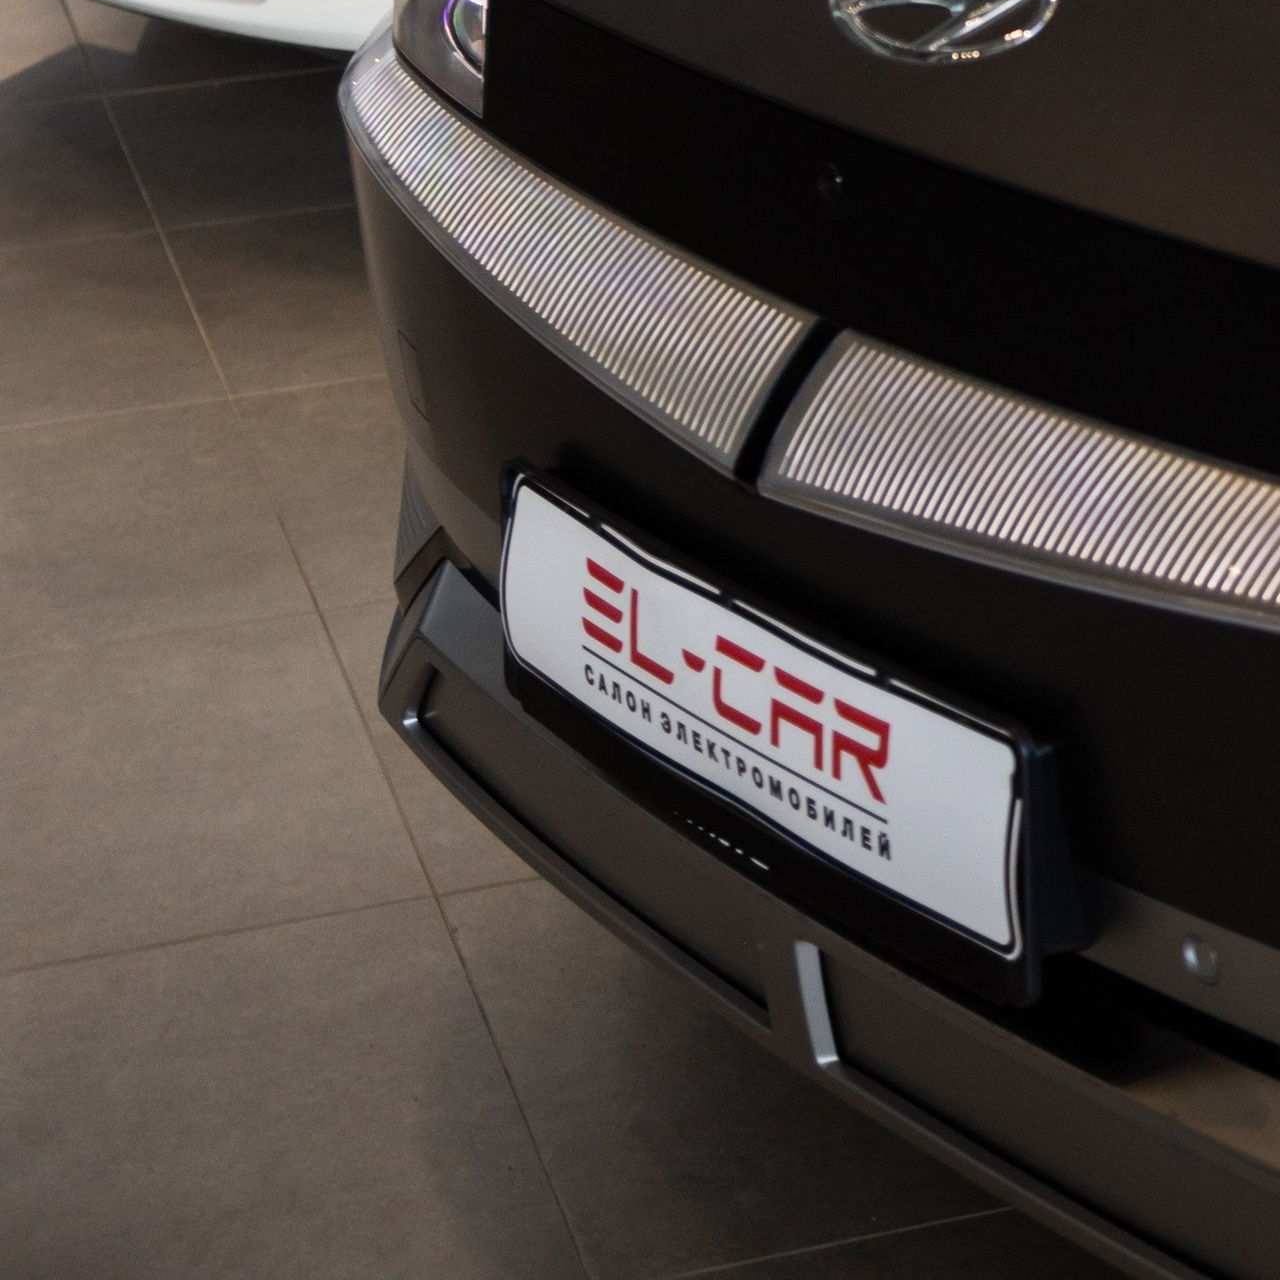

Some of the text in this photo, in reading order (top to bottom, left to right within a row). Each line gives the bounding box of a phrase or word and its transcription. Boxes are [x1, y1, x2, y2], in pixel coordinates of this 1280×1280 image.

[581, 556, 891, 806] EL-CAR
[583, 663, 892, 862] САЛОН ЭЛЕКТРОМОБИЛЕЙ
